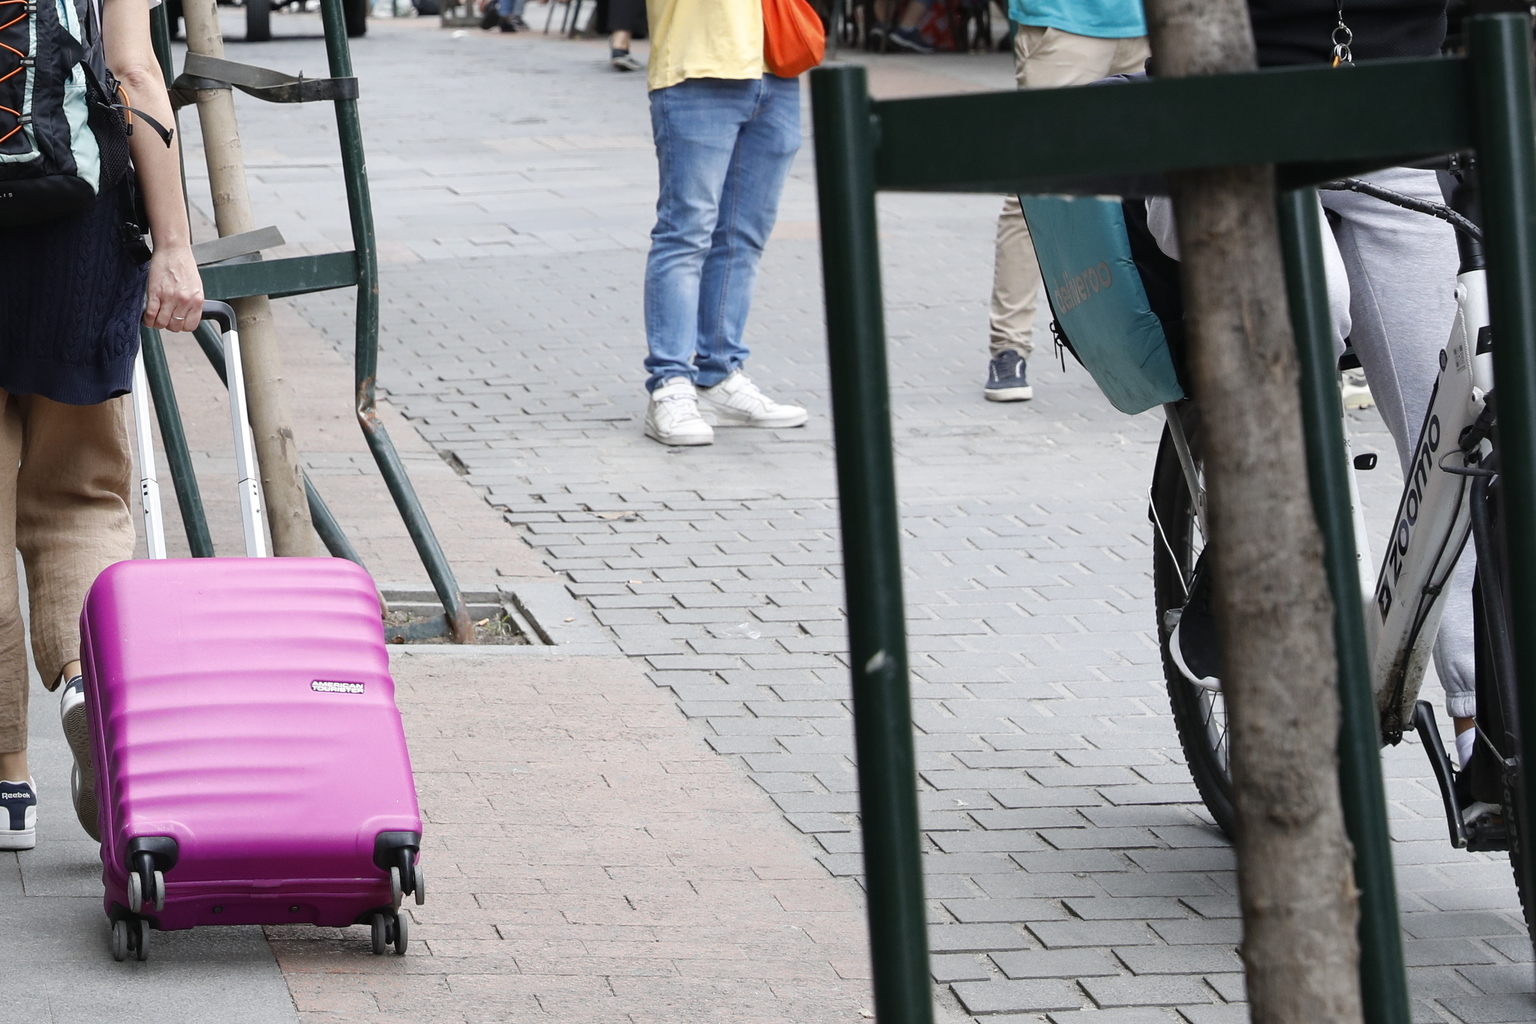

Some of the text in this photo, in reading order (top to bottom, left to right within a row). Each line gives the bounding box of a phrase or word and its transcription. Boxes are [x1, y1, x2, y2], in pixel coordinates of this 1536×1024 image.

[1053, 261, 1112, 315] deliveroo
[1389, 414, 1441, 589] zoomo
[312, 681, 363, 689] AMERICAN
[312, 686, 363, 694] TOURISTER
[1, 791, 31, 800] Reebok
